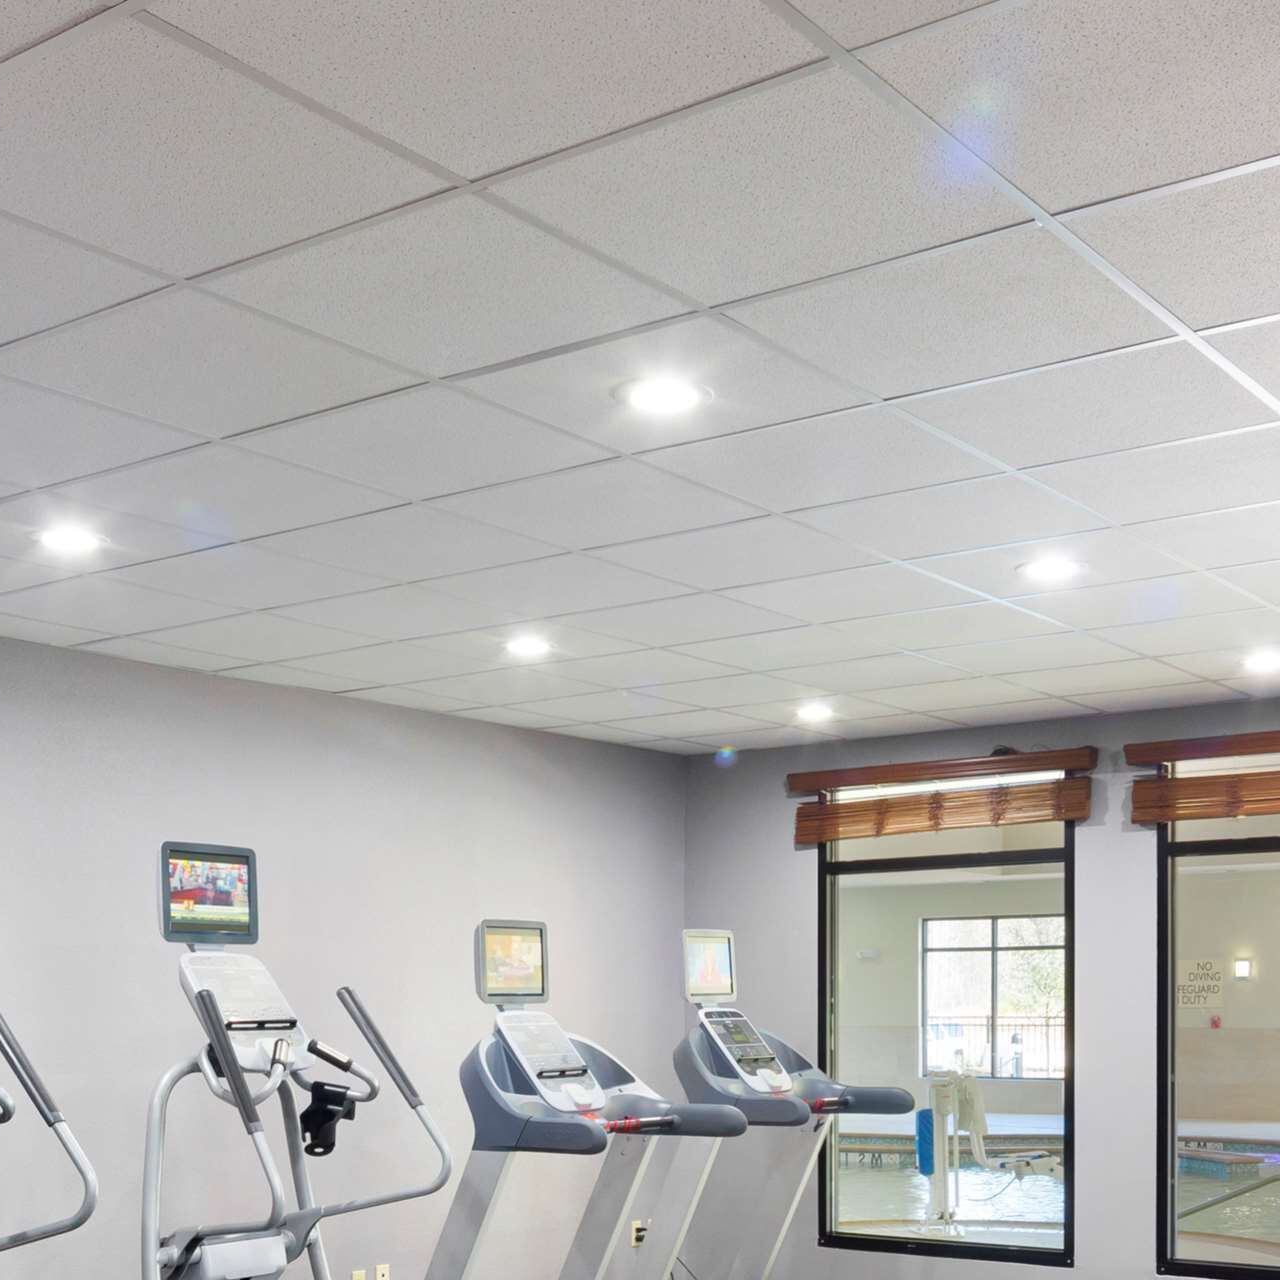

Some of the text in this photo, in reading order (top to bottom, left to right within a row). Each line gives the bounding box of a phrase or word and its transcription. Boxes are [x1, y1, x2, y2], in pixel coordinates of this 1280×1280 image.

[1196, 961, 1213, 971] NO
[1188, 972, 1221, 981] DIVING
[1177, 984, 1219, 994] FEGUARD
[1182, 995, 1208, 1004] DUTY
